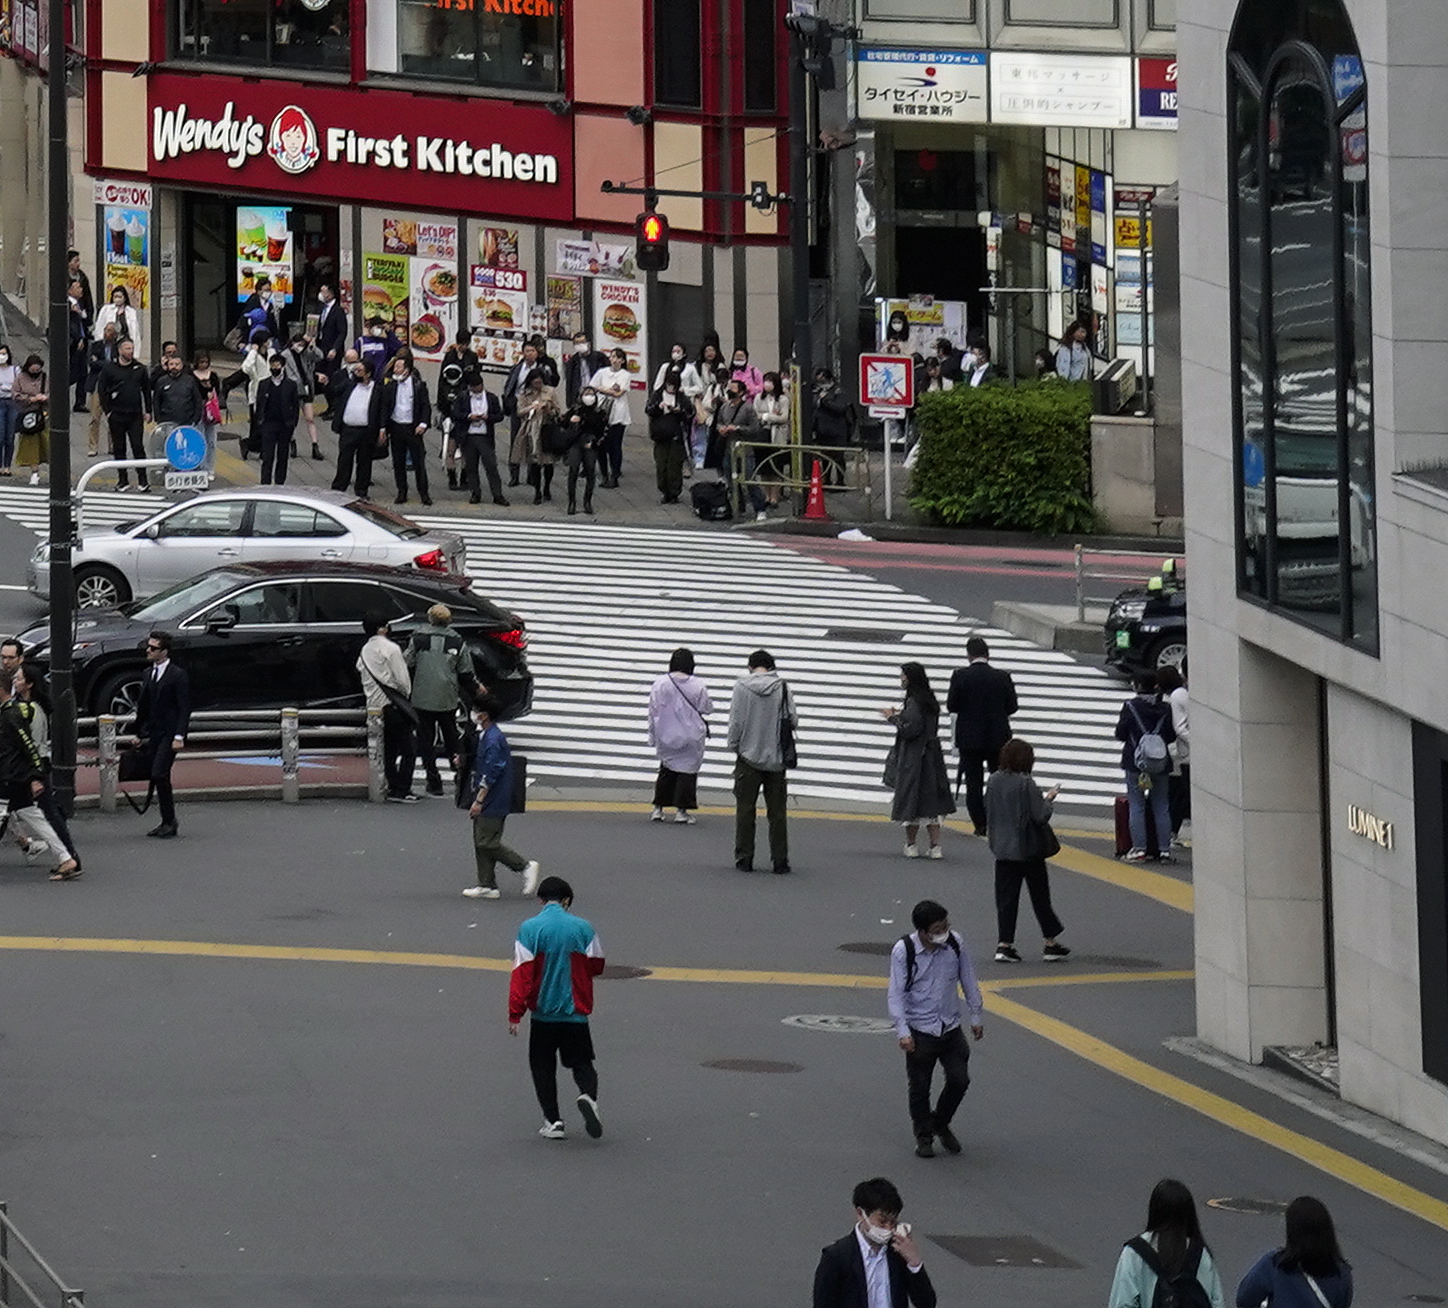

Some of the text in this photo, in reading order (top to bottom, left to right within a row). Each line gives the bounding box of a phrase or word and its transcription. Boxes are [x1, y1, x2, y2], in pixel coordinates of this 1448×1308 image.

[864, 87, 981, 104] タイセイ・ハウジー
[892, 103, 954, 117] 新宿営業所
[152, 100, 558, 184] Wendy's First Kitchen
